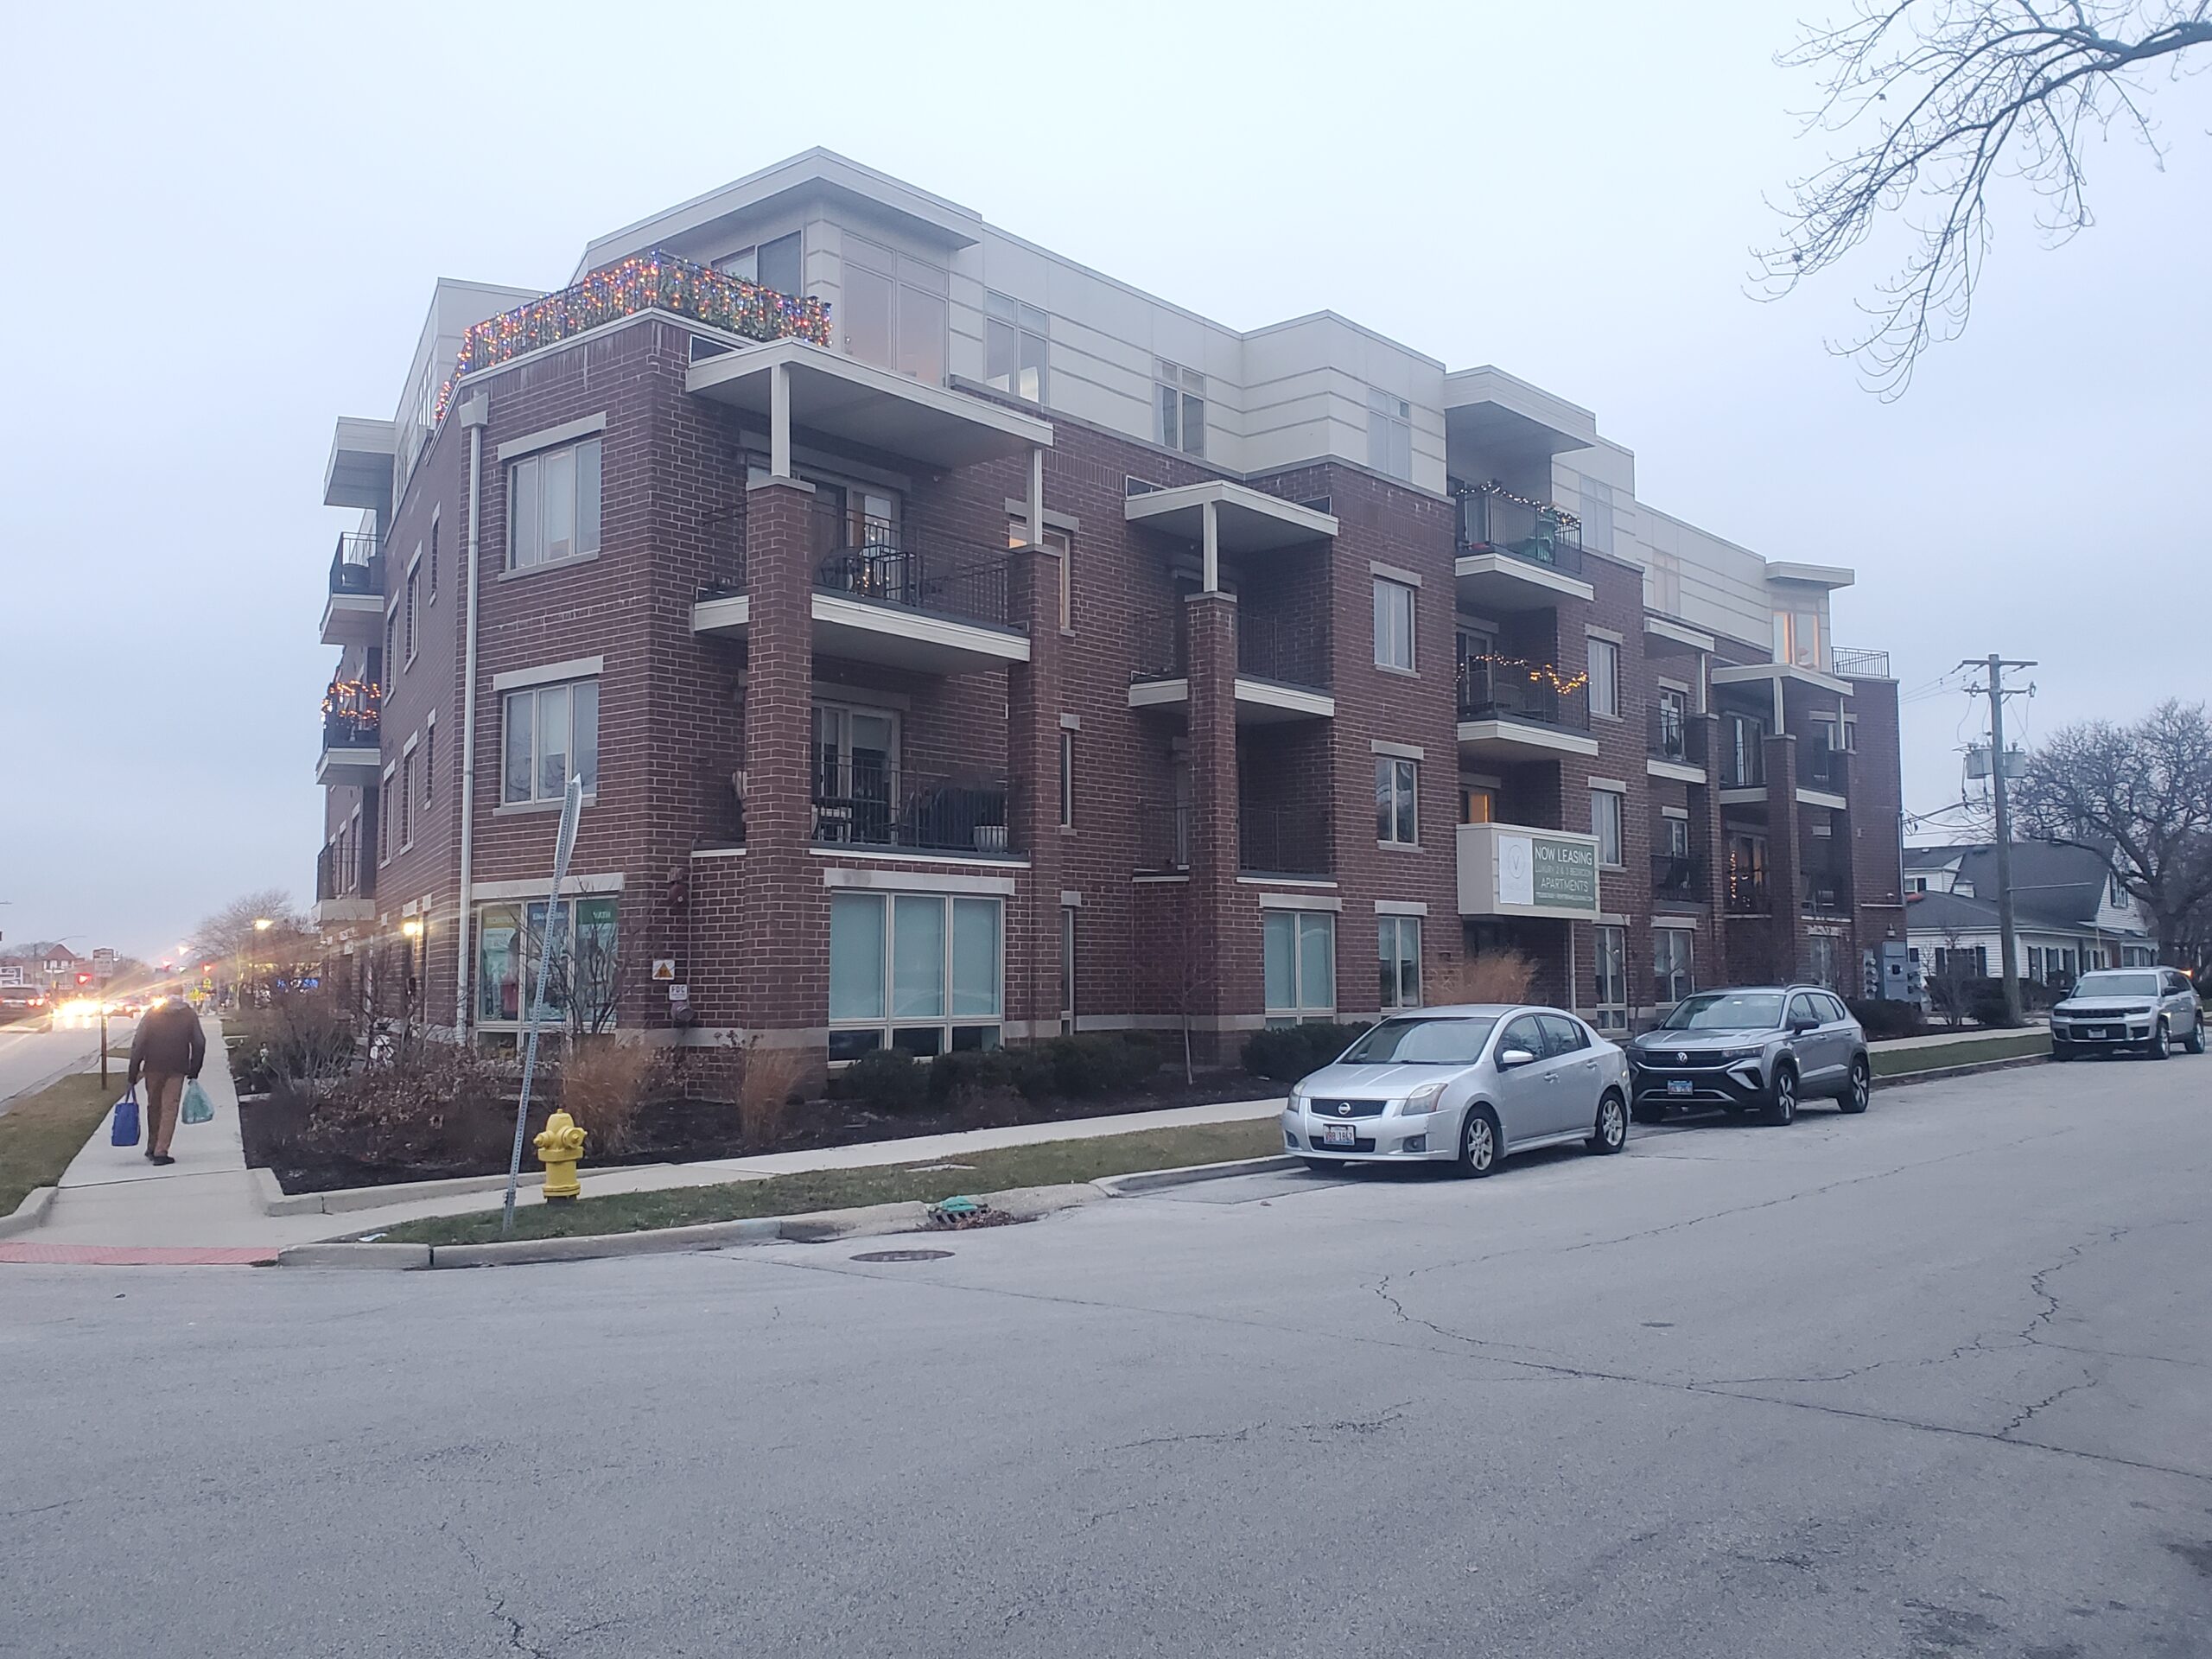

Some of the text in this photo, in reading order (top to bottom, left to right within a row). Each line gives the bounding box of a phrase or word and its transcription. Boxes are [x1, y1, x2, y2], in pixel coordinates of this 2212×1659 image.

[1535, 846, 1592, 866] NOW LEASING
[1541, 877, 1589, 892] APARTMENTS
